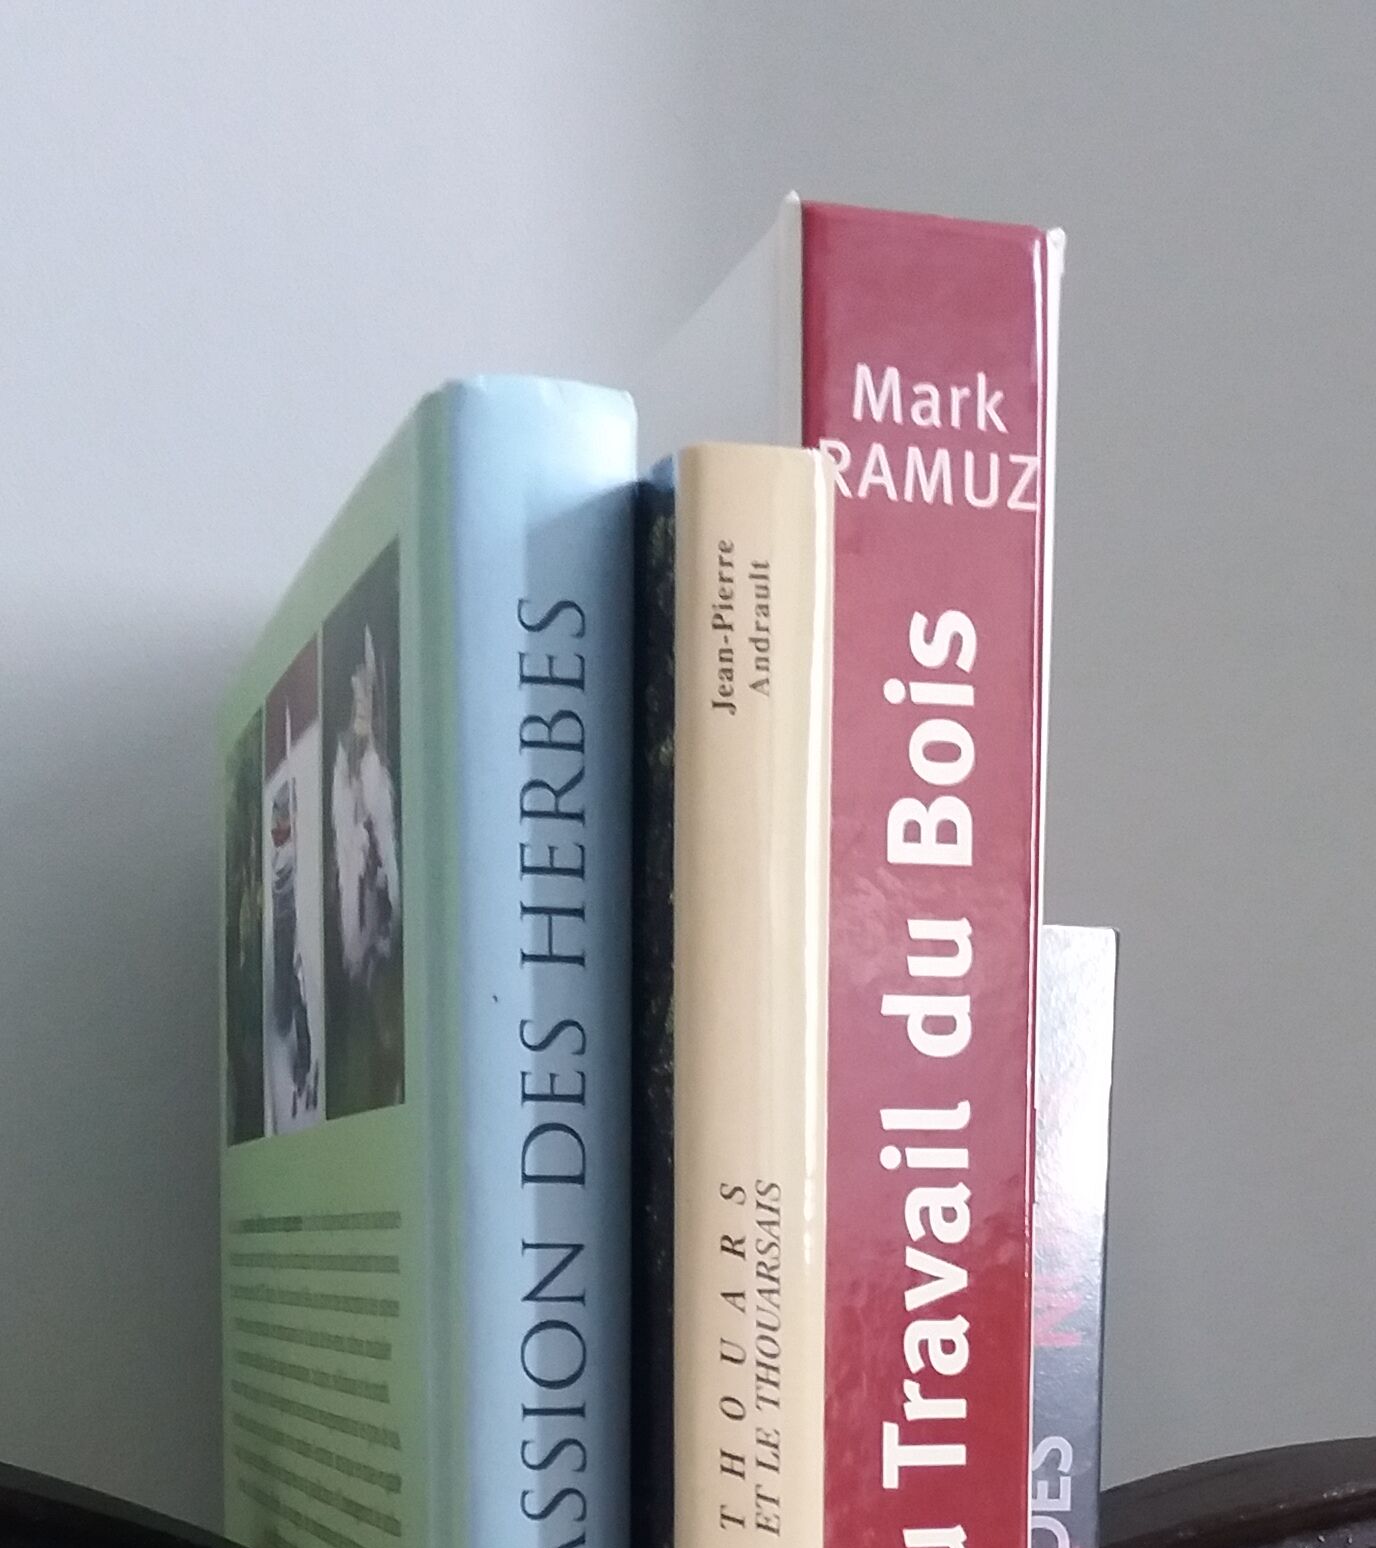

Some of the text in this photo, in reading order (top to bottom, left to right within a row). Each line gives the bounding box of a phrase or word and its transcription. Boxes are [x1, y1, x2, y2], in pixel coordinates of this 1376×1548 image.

[819, 437, 1041, 512] RAMUZ
[853, 362, 1009, 434] Mark
[711, 539, 737, 716] Jean-Pierre
[748, 559, 770, 697] Andrault
[517, 598, 586, 968] HERBES
[882, 609, 978, 867] Bois
[880, 917, 974, 1058] du
[519, 1019, 587, 1189] DES
[754, 1179, 782, 1537] ET LE THOUARSAIS
[878, 1100, 973, 1490] Travail
